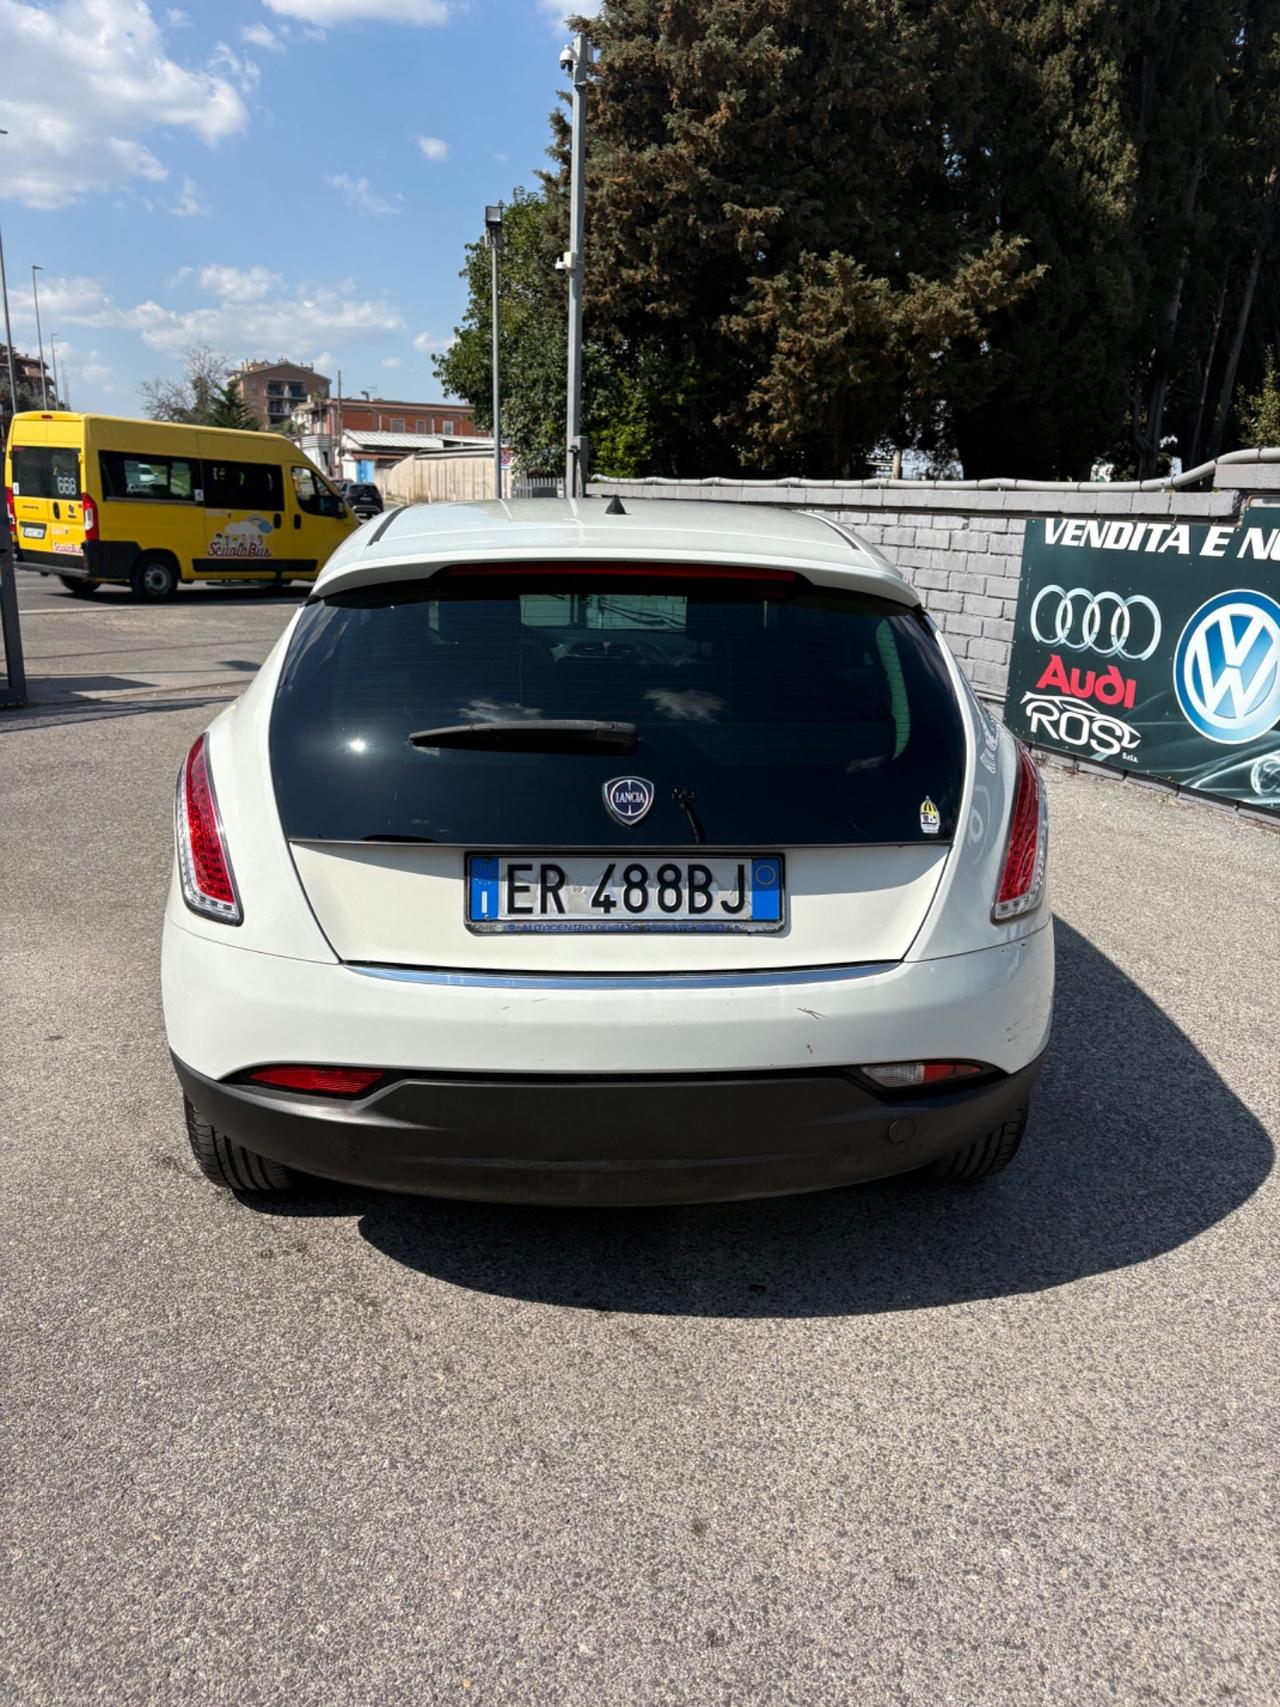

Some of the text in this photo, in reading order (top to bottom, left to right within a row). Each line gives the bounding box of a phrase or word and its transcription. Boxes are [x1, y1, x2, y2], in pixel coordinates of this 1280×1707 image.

[1044, 518, 1190, 555] VENDITA
[1199, 526, 1236, 557] E
[1036, 654, 1137, 709] Audi
[615, 792, 645, 803] LANCIA
[507, 863, 566, 914] ER
